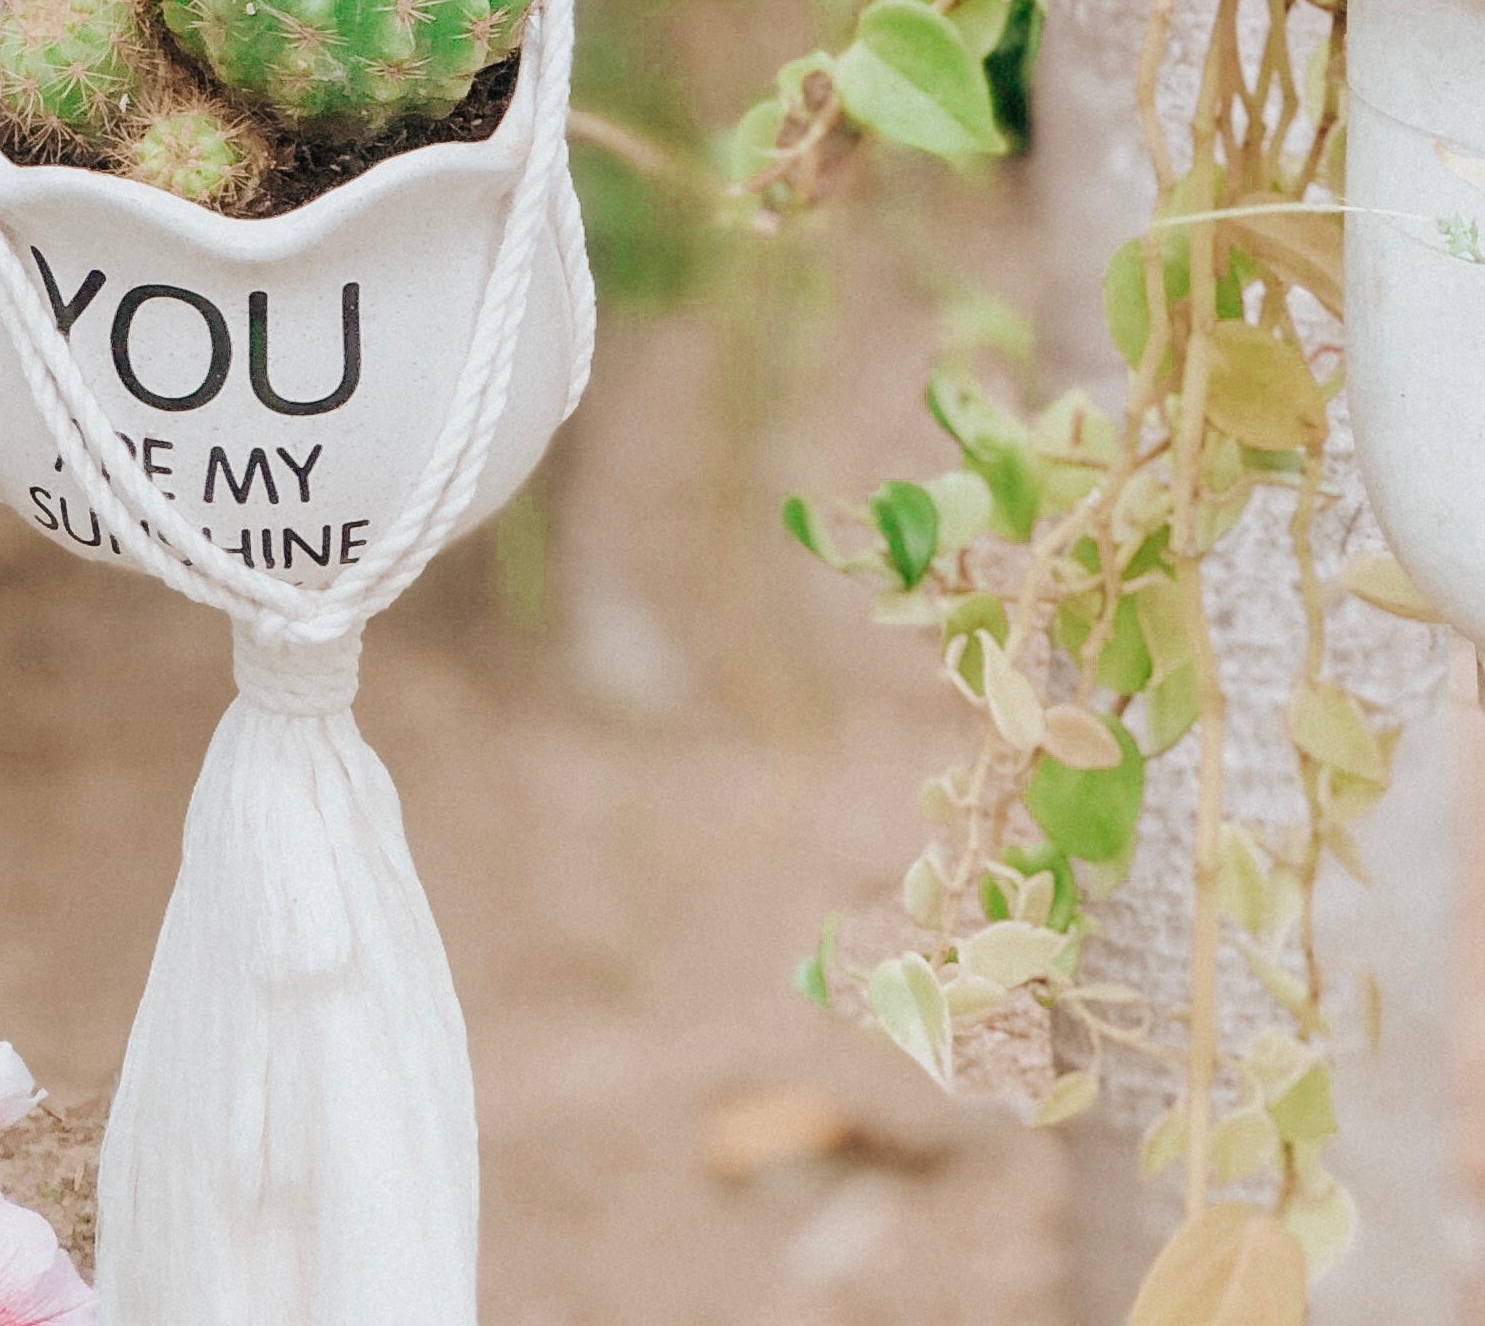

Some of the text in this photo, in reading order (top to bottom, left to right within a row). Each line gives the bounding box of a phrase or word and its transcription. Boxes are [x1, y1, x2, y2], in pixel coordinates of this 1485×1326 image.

[30, 245, 362, 416] YOU
[203, 444, 323, 505] MY
[29, 486, 371, 569] SUHINE
